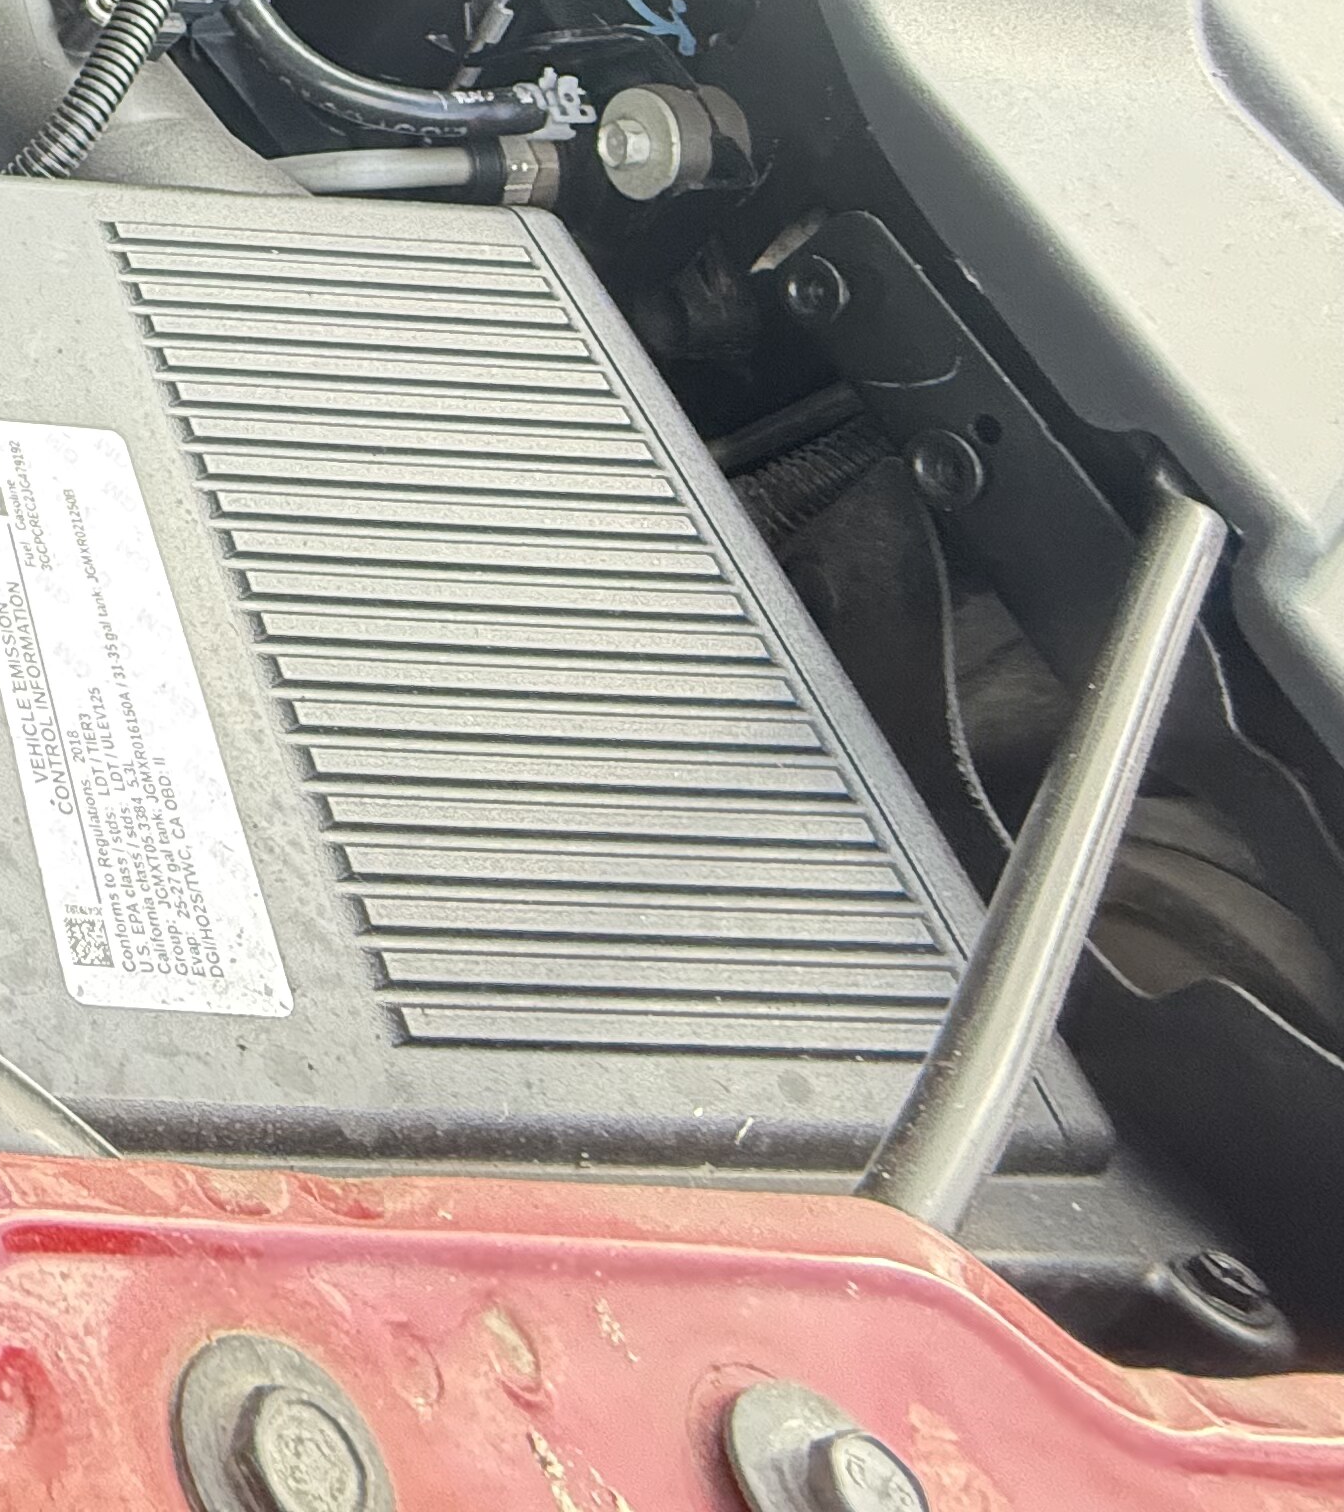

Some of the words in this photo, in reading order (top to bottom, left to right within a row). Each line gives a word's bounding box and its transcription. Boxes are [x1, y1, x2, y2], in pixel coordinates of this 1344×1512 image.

[6, 479, 26, 530] Gasoline
[6, 581, 47, 709] INFORMATION
[98, 621, 118, 641] gal
[103, 643, 126, 679] 31-35
[77, 712, 99, 754] TIER3
[87, 686, 114, 749] ULEV125
[15, 698, 48, 783] VEHICLE
[65, 729, 85, 762] 2018
[118, 691, 158, 803] JGMXR016150A
[39, 716, 73, 815] CONTROL
[90, 766, 110, 796] LDT
[106, 761, 126, 791] LDT
[121, 759, 139, 787] 5.3L
[157, 770, 178, 810] OBD:
[168, 816, 186, 839] CA
[103, 872, 116, 888] to
[116, 856, 136, 897] class
[128, 851, 151, 892] class
[159, 849, 181, 872] gal
[166, 876, 190, 918] 25-27
[177, 845, 224, 978] DGI/HO2S/TWC,
[108, 892, 136, 972] Conforms
[125, 902, 146, 934] EPA
[142, 896, 171, 974] California
[135, 941, 155, 973] U.S.
[165, 919, 192, 976] Group:
[180, 931, 206, 977] Evap:
